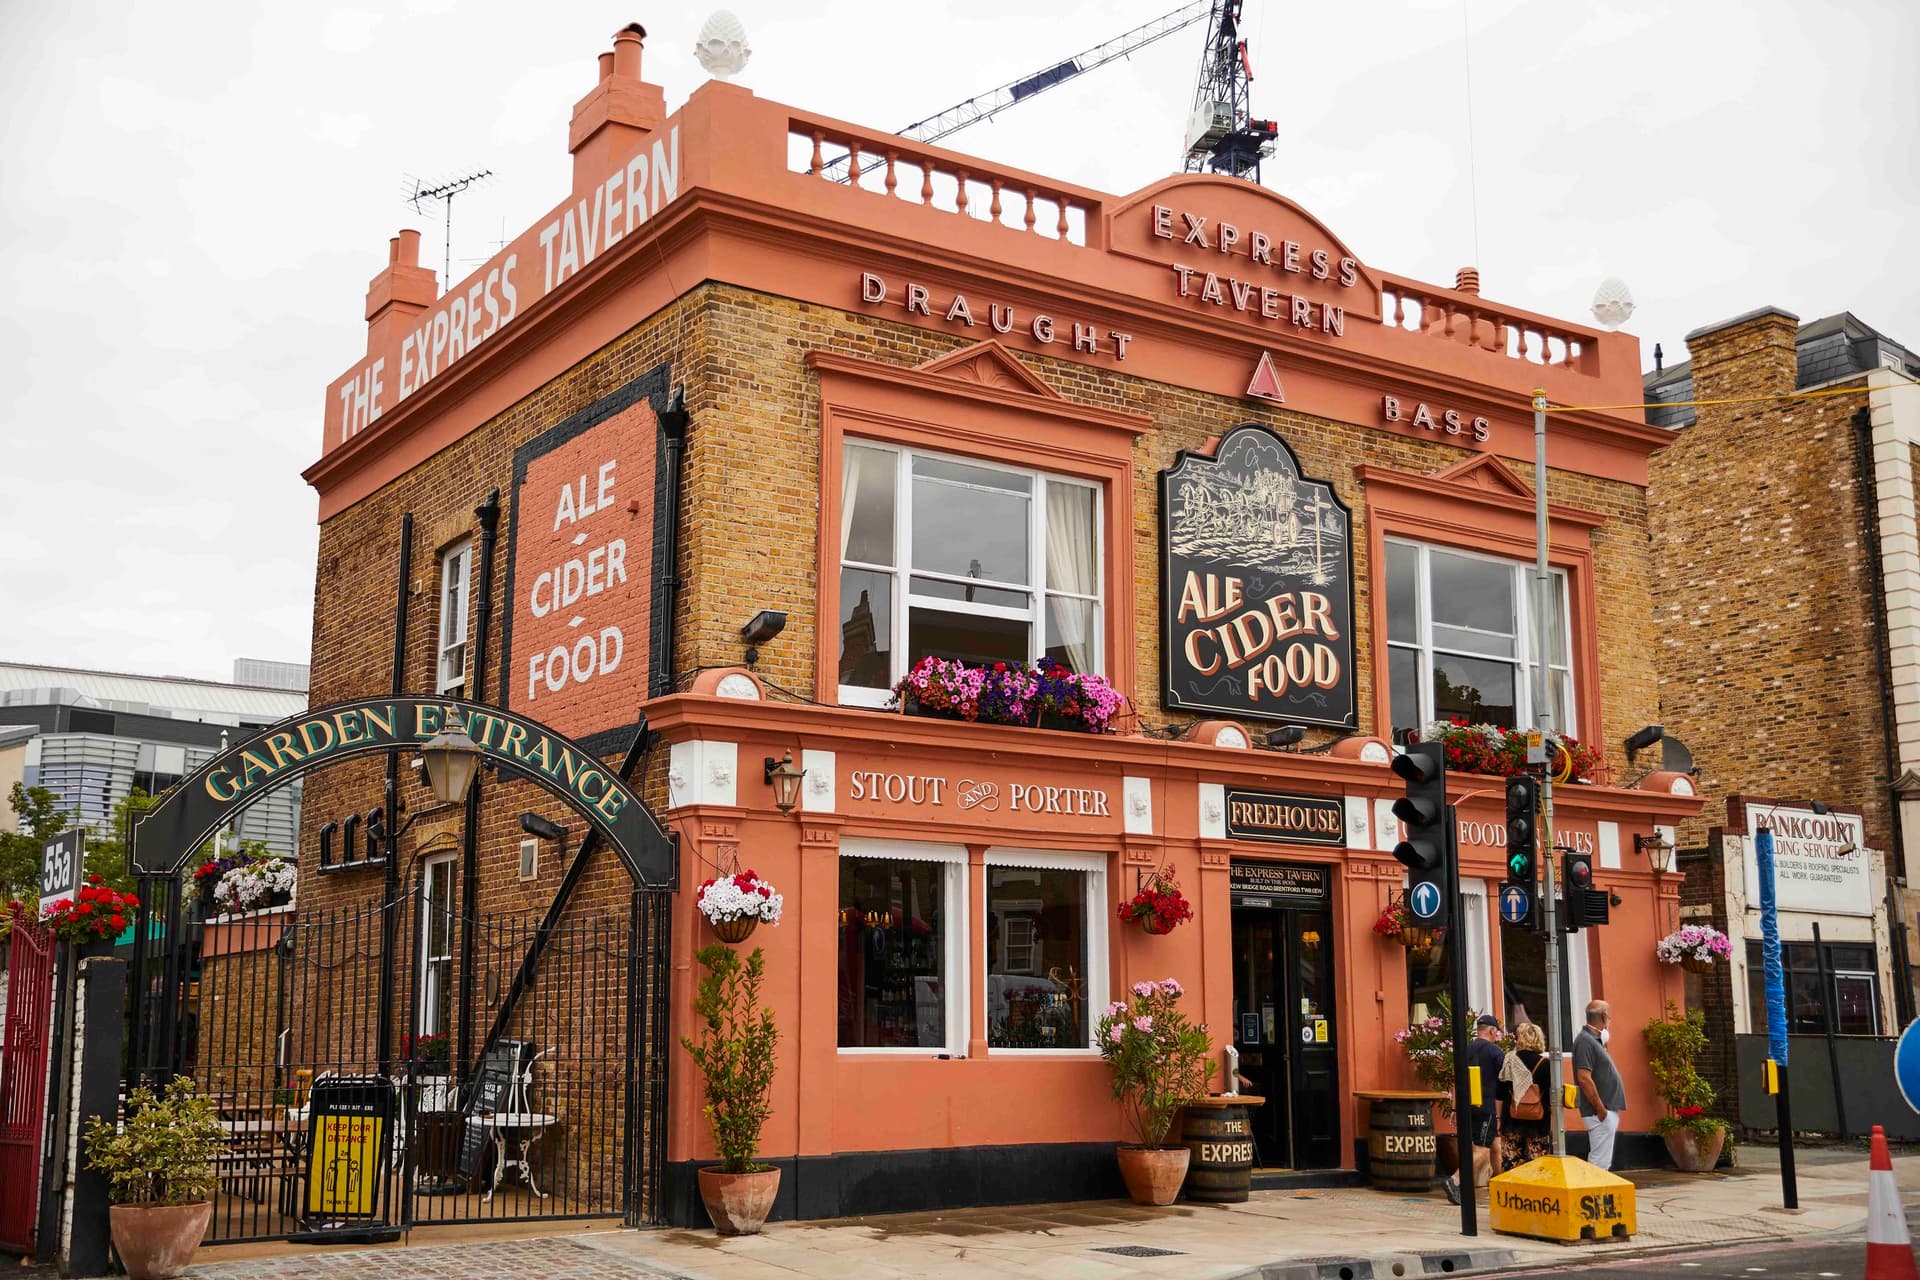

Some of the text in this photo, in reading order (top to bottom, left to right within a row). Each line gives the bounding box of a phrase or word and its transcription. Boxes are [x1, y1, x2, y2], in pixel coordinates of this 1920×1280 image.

[1153, 204, 1357, 287] EXPRESS
[341, 126, 680, 444] THE EXPRESS TAVERN
[1172, 263, 1344, 337] TAVERN
[861, 272, 1132, 360] DRAUGHT
[1383, 395, 1490, 442] BASS
[553, 459, 617, 532] ALE
[530, 538, 628, 618] CIDER
[1177, 570, 1244, 623] ALE
[1184, 591, 1340, 676] CIDER
[528, 626, 624, 700] FOOD
[1247, 642, 1341, 701] FOOD
[205, 704, 397, 802] GARDEN
[850, 770, 1111, 817] STOUT AND PORTER
[1231, 801, 1340, 834] FREEHOUSE
[1459, 821, 1507, 847] FOOD
[1556, 830, 1593, 854] ALES
[44, 842, 71, 892] 55a
[1231, 866, 1320, 881] HE EXPRESS TAVERN
[1792, 872, 1808, 880] WORK
[1810, 873, 1843, 883] GUARANTEED
[1225, 1121, 1242, 1133] THE
[1408, 1114, 1425, 1125] THE
[1497, 1191, 1560, 1216] Urban64
